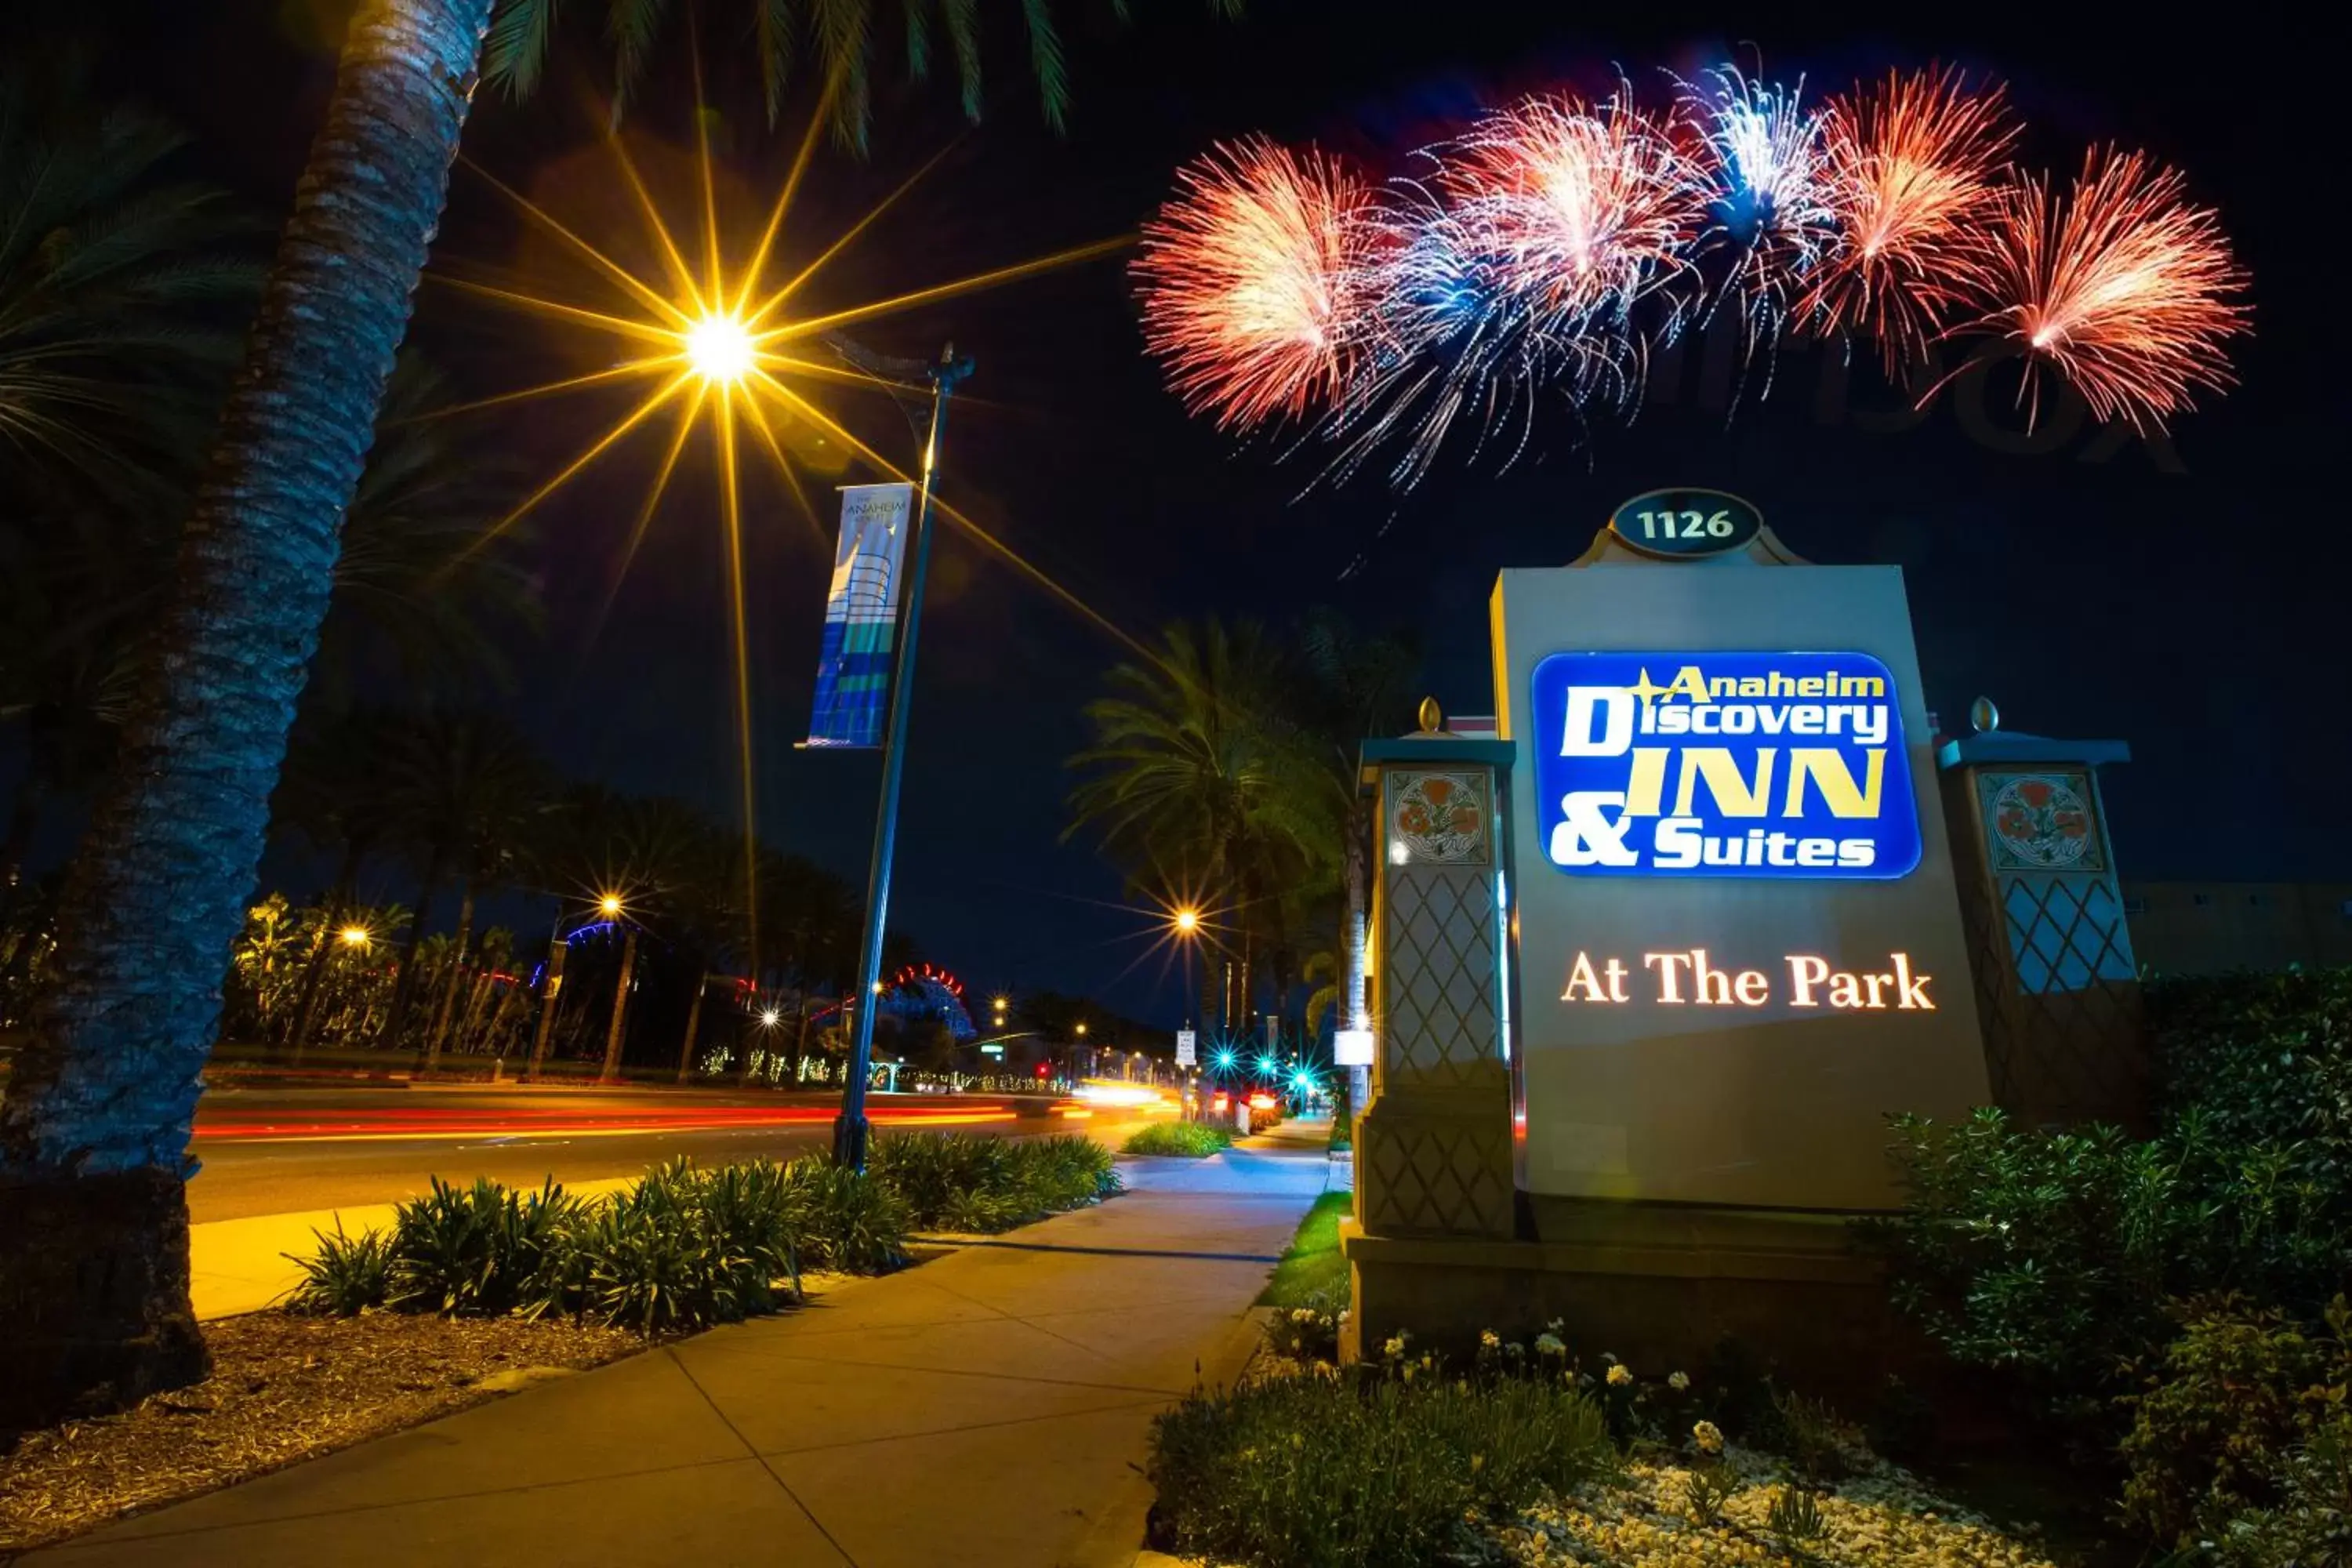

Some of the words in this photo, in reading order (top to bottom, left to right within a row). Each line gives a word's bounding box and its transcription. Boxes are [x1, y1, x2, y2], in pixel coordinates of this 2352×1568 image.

[1636, 510, 1734, 539] 1126
[1661, 666, 1885, 703] Anaheim
[1559, 686, 1888, 757] Discovery
[1622, 747, 1887, 818] INN
[1550, 790, 1639, 867] &
[1653, 818, 1876, 869] Suites
[1560, 950, 1630, 1004] At
[1644, 948, 1769, 1007] The
[1784, 953, 1936, 1011] Park
